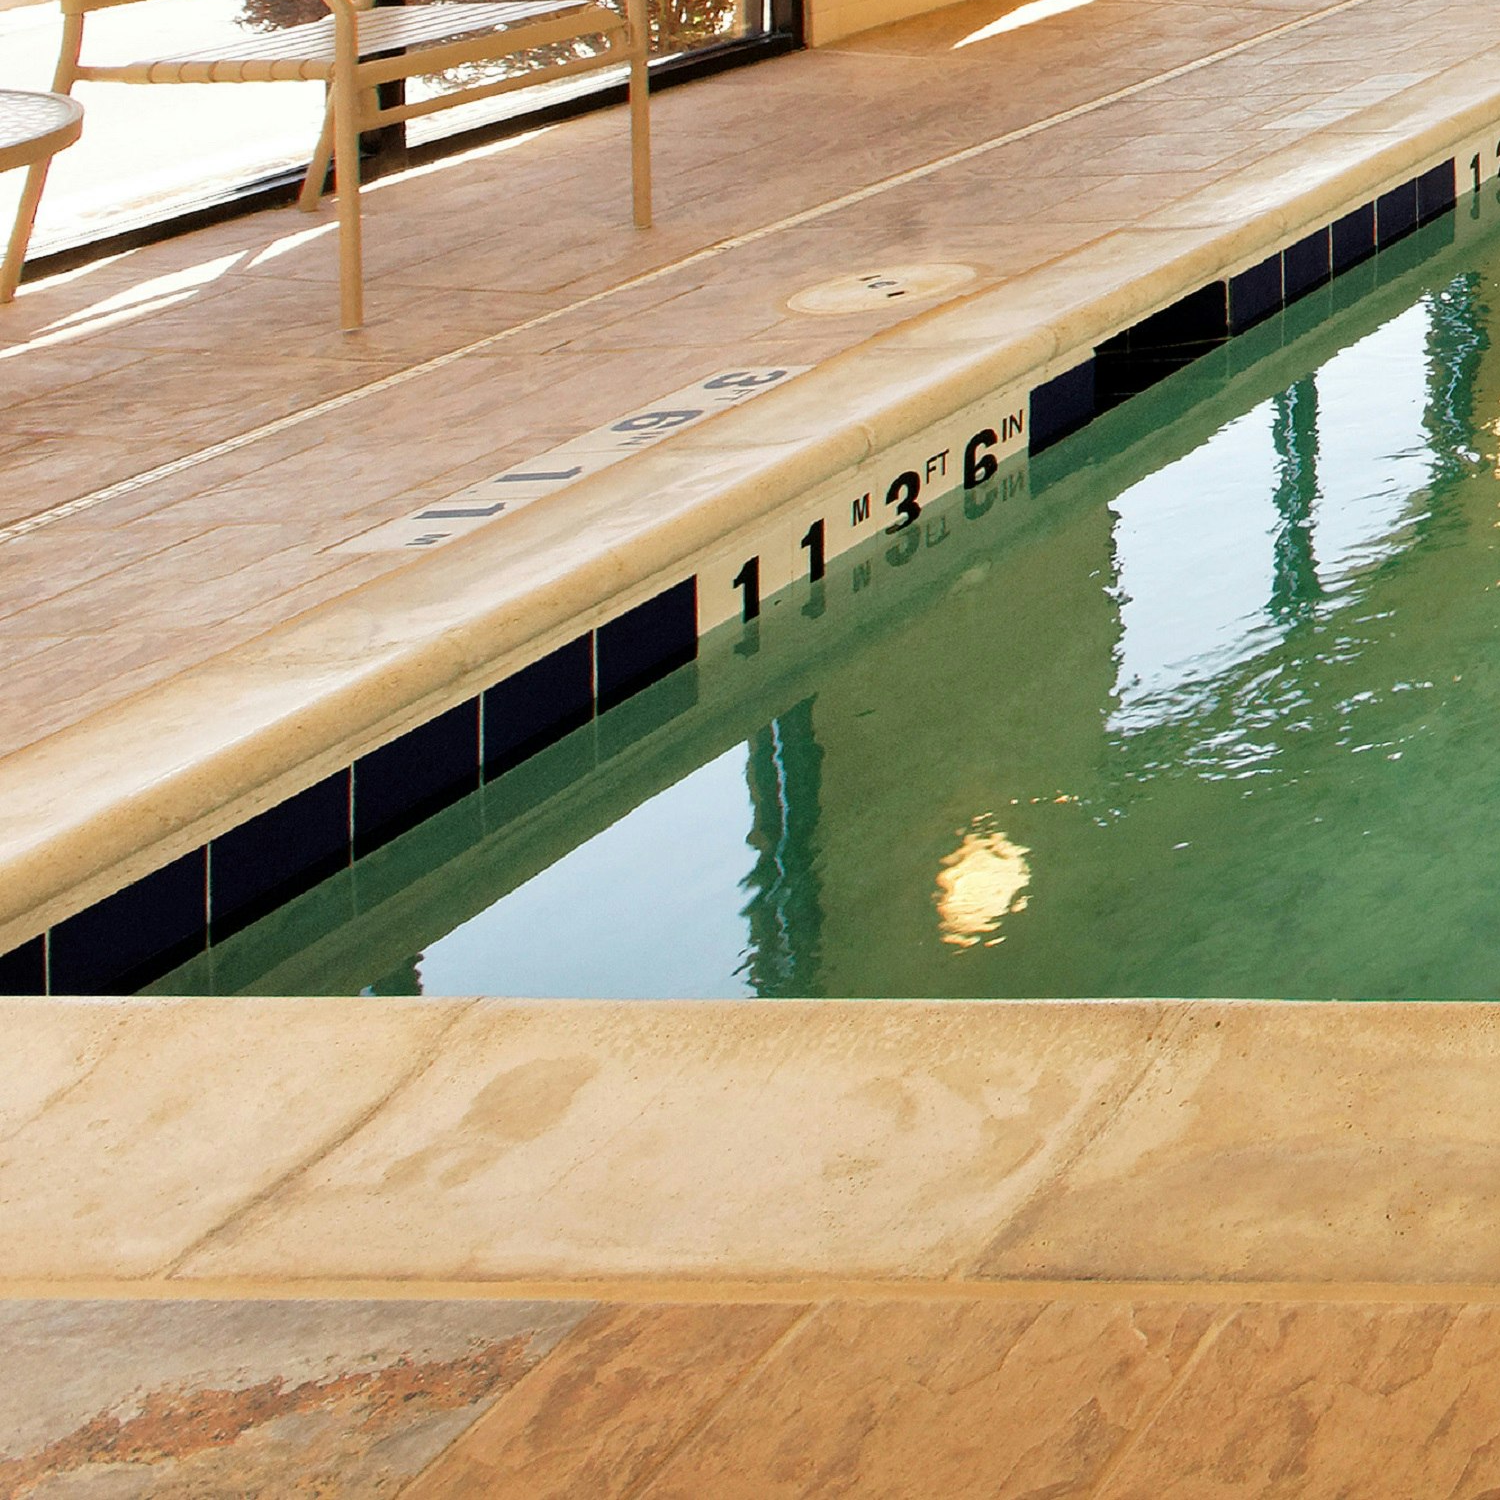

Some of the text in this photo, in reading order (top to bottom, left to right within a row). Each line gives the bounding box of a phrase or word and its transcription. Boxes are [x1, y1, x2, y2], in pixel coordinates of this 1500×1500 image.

[851, 491, 871, 527] M
[885, 470, 921, 533] 3
[925, 448, 951, 484] FT
[963, 428, 999, 490] 6
[1001, 409, 1024, 444] IN
